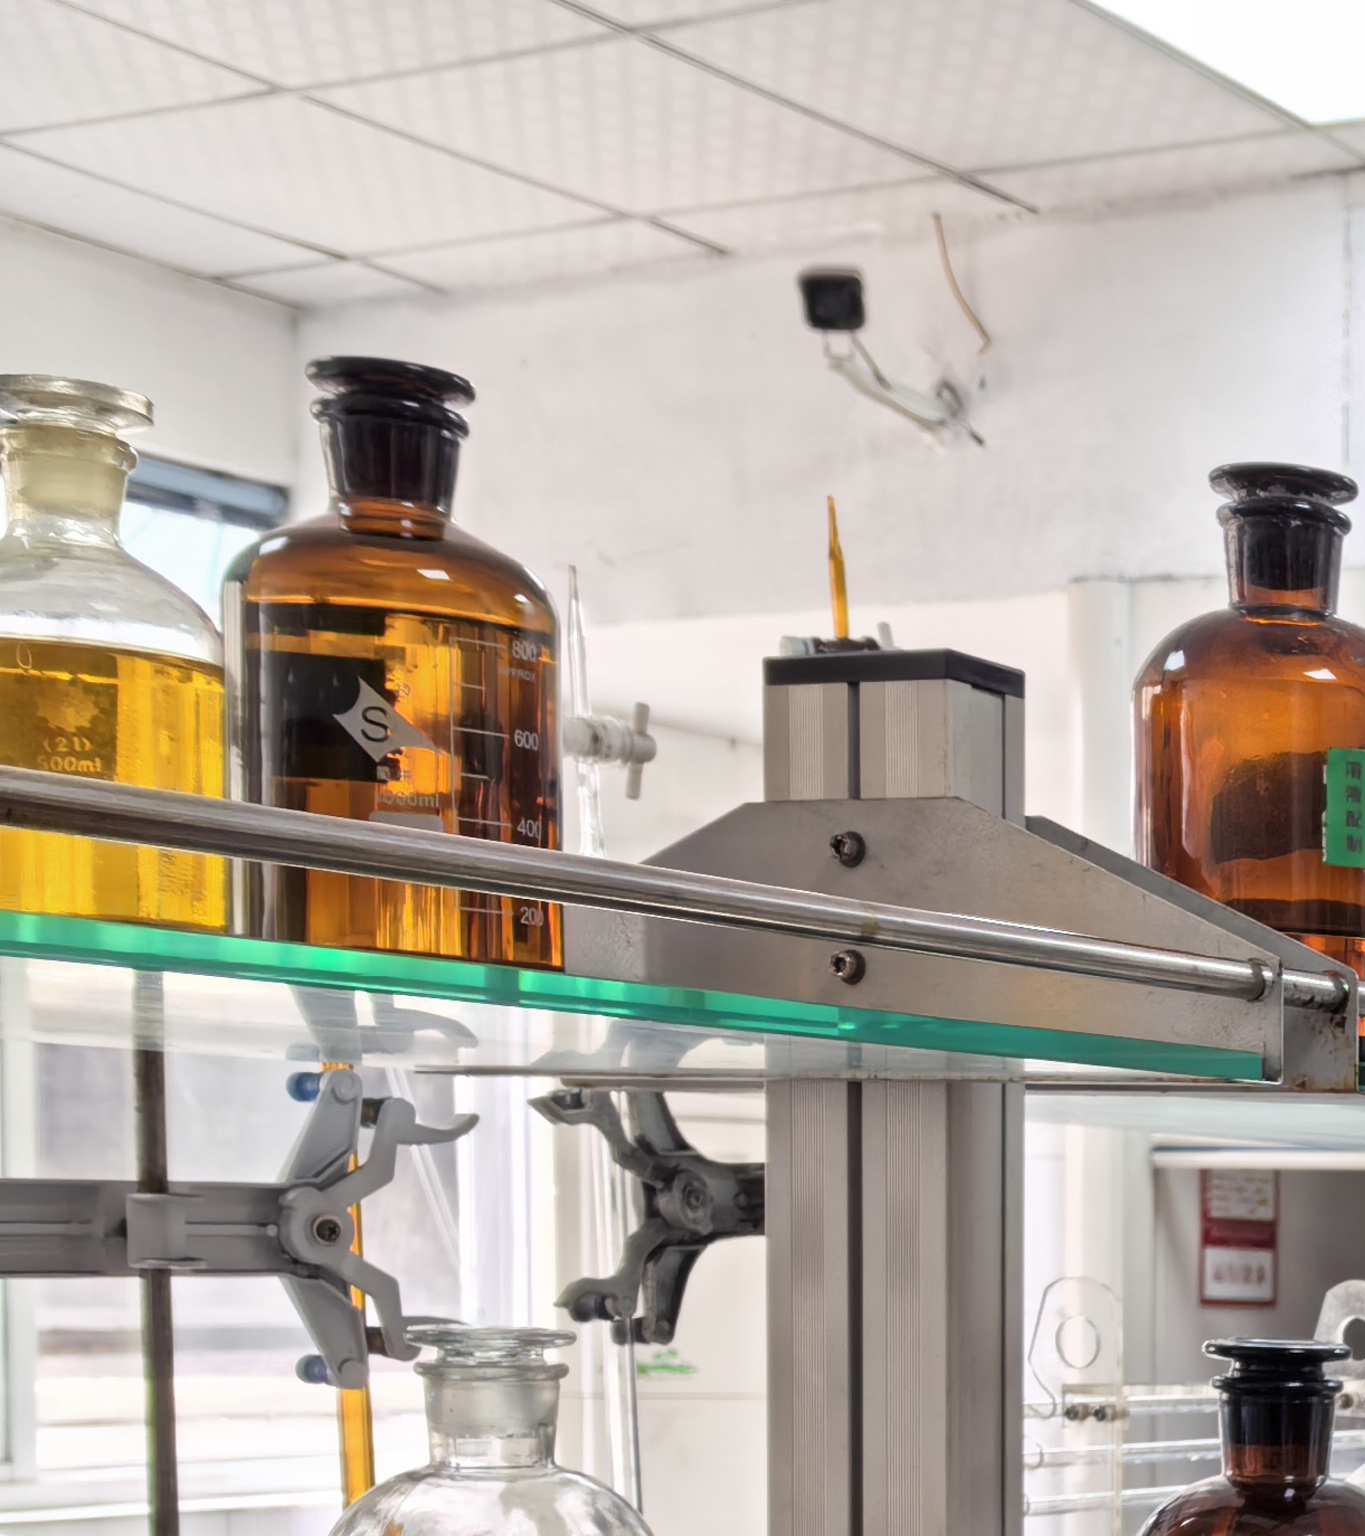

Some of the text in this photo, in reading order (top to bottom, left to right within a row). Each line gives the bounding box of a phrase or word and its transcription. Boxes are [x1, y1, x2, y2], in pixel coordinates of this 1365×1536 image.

[512, 640, 537, 662] 800
[361, 706, 390, 743] S
[514, 731, 538, 750] 600
[517, 820, 541, 839] 400
[519, 907, 543, 927] 200
